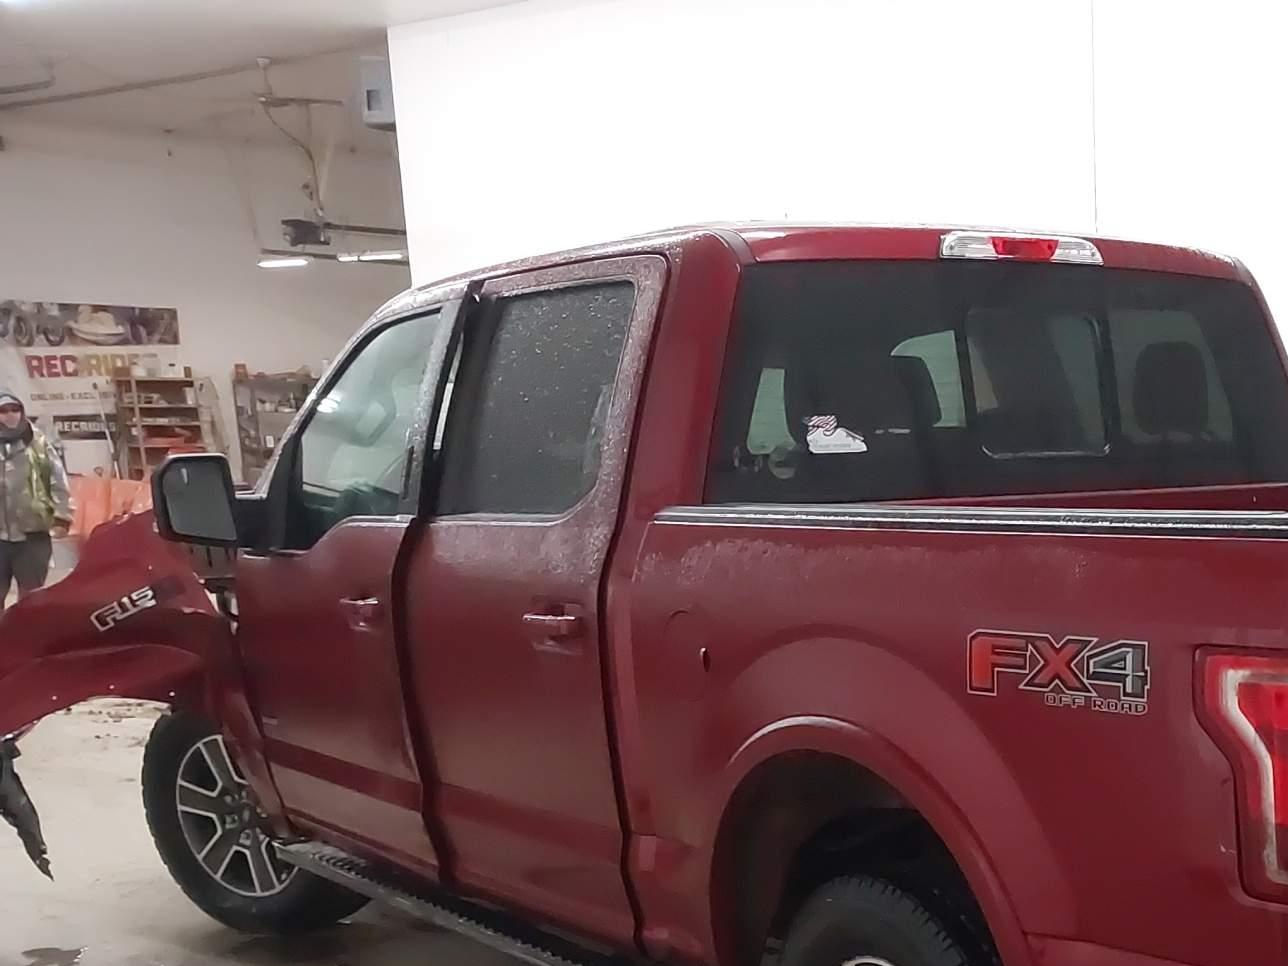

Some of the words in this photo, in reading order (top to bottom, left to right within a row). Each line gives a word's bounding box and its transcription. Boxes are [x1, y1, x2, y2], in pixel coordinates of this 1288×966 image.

[25, 355, 79, 378] REC
[967, 628, 1150, 702] FX4
[1045, 693, 1085, 708] OFF
[1091, 697, 1149, 716] ROAD
